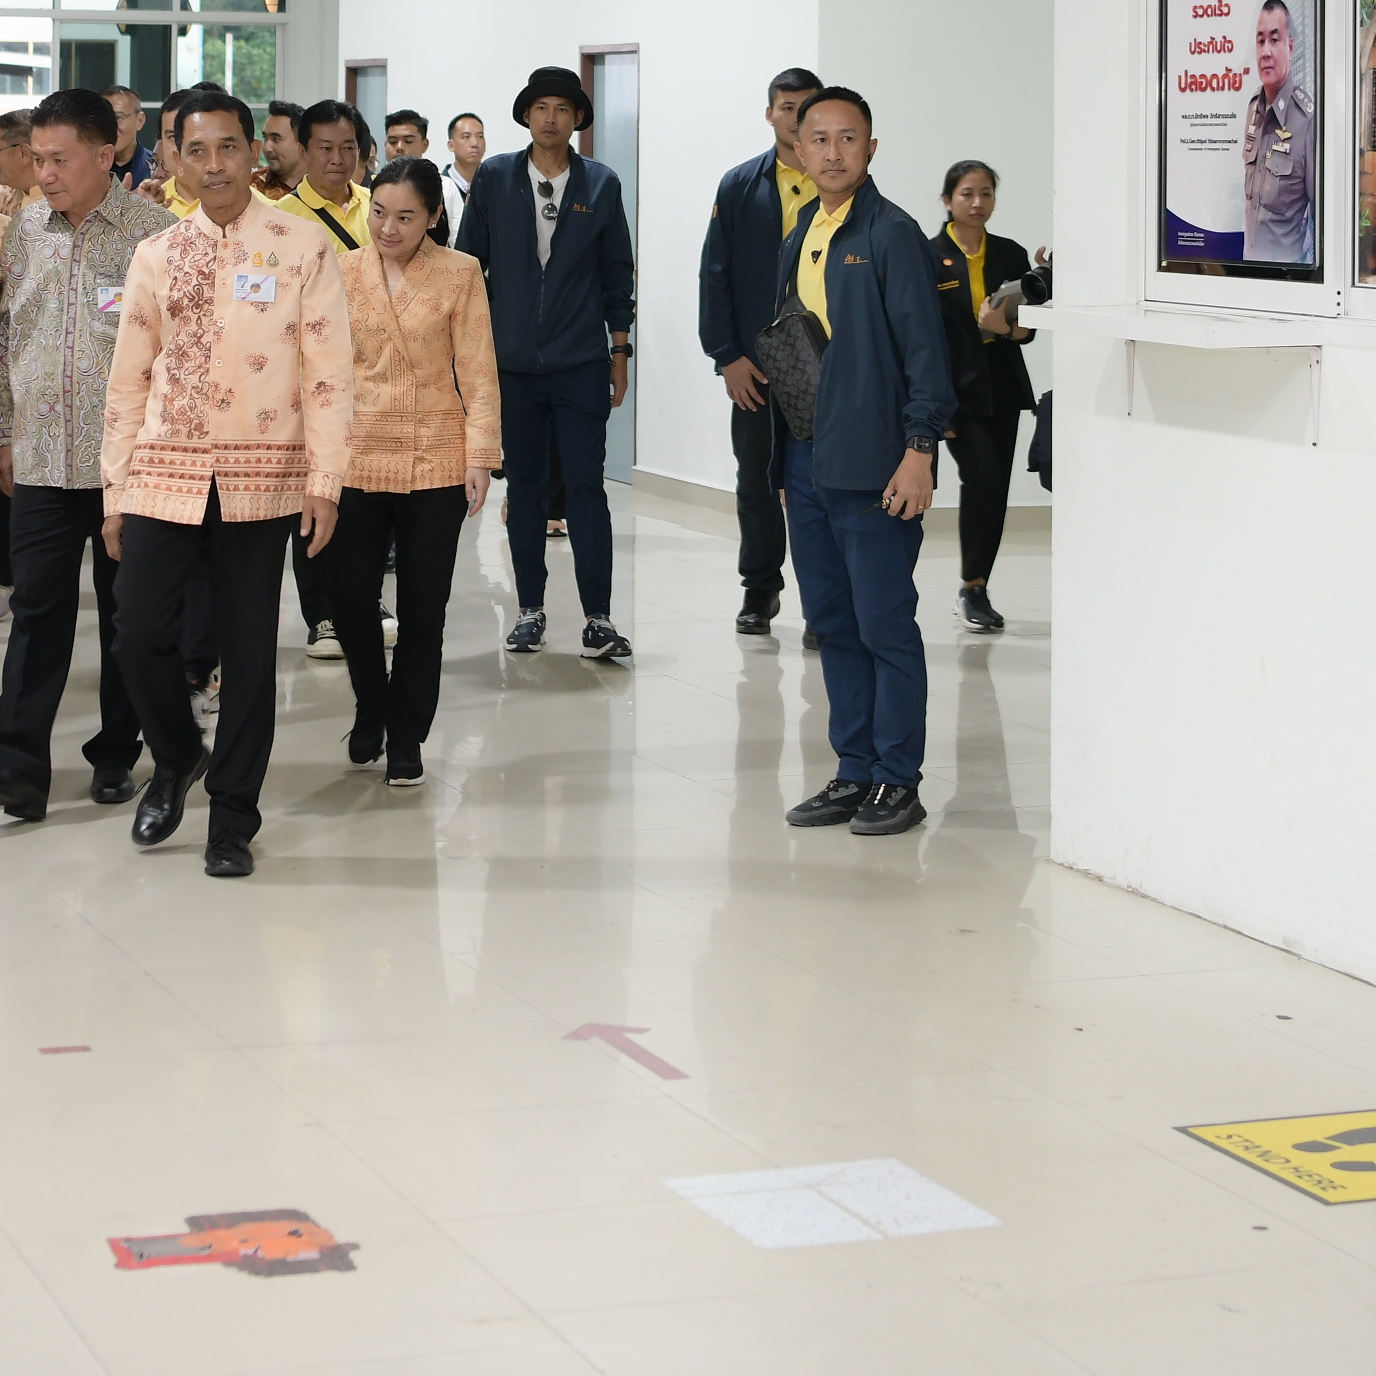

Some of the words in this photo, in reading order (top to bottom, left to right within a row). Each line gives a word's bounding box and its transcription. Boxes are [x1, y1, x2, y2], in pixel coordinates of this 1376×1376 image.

[1189, 35, 1234, 55] ประทับใจ
[1215, 1133, 1291, 1167] STAND
[1285, 1165, 1348, 1195] HERE
